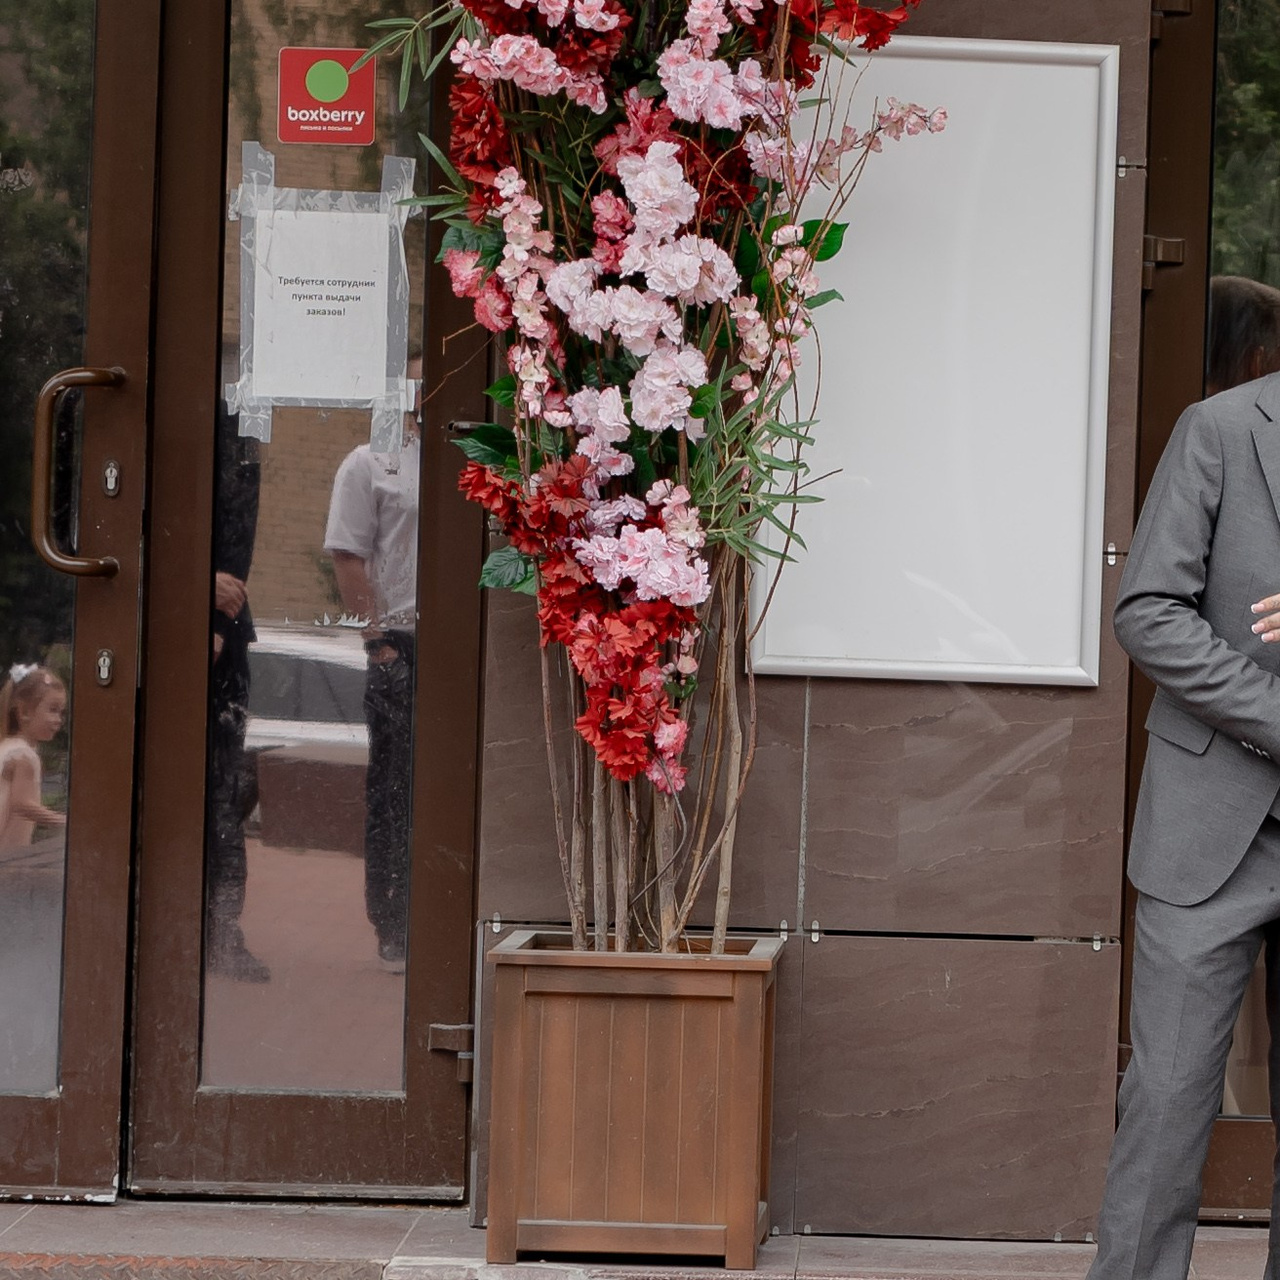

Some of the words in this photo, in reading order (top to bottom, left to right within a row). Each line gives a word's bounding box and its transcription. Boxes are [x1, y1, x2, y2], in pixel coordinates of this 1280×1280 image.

[287, 106, 365, 125] boxberry
[278, 276, 325, 287] Требуется
[327, 279, 376, 288] сотрудник
[291, 293, 323, 302] пункта
[325, 294, 361, 302] выдачи
[306, 307, 346, 316] заказов!
